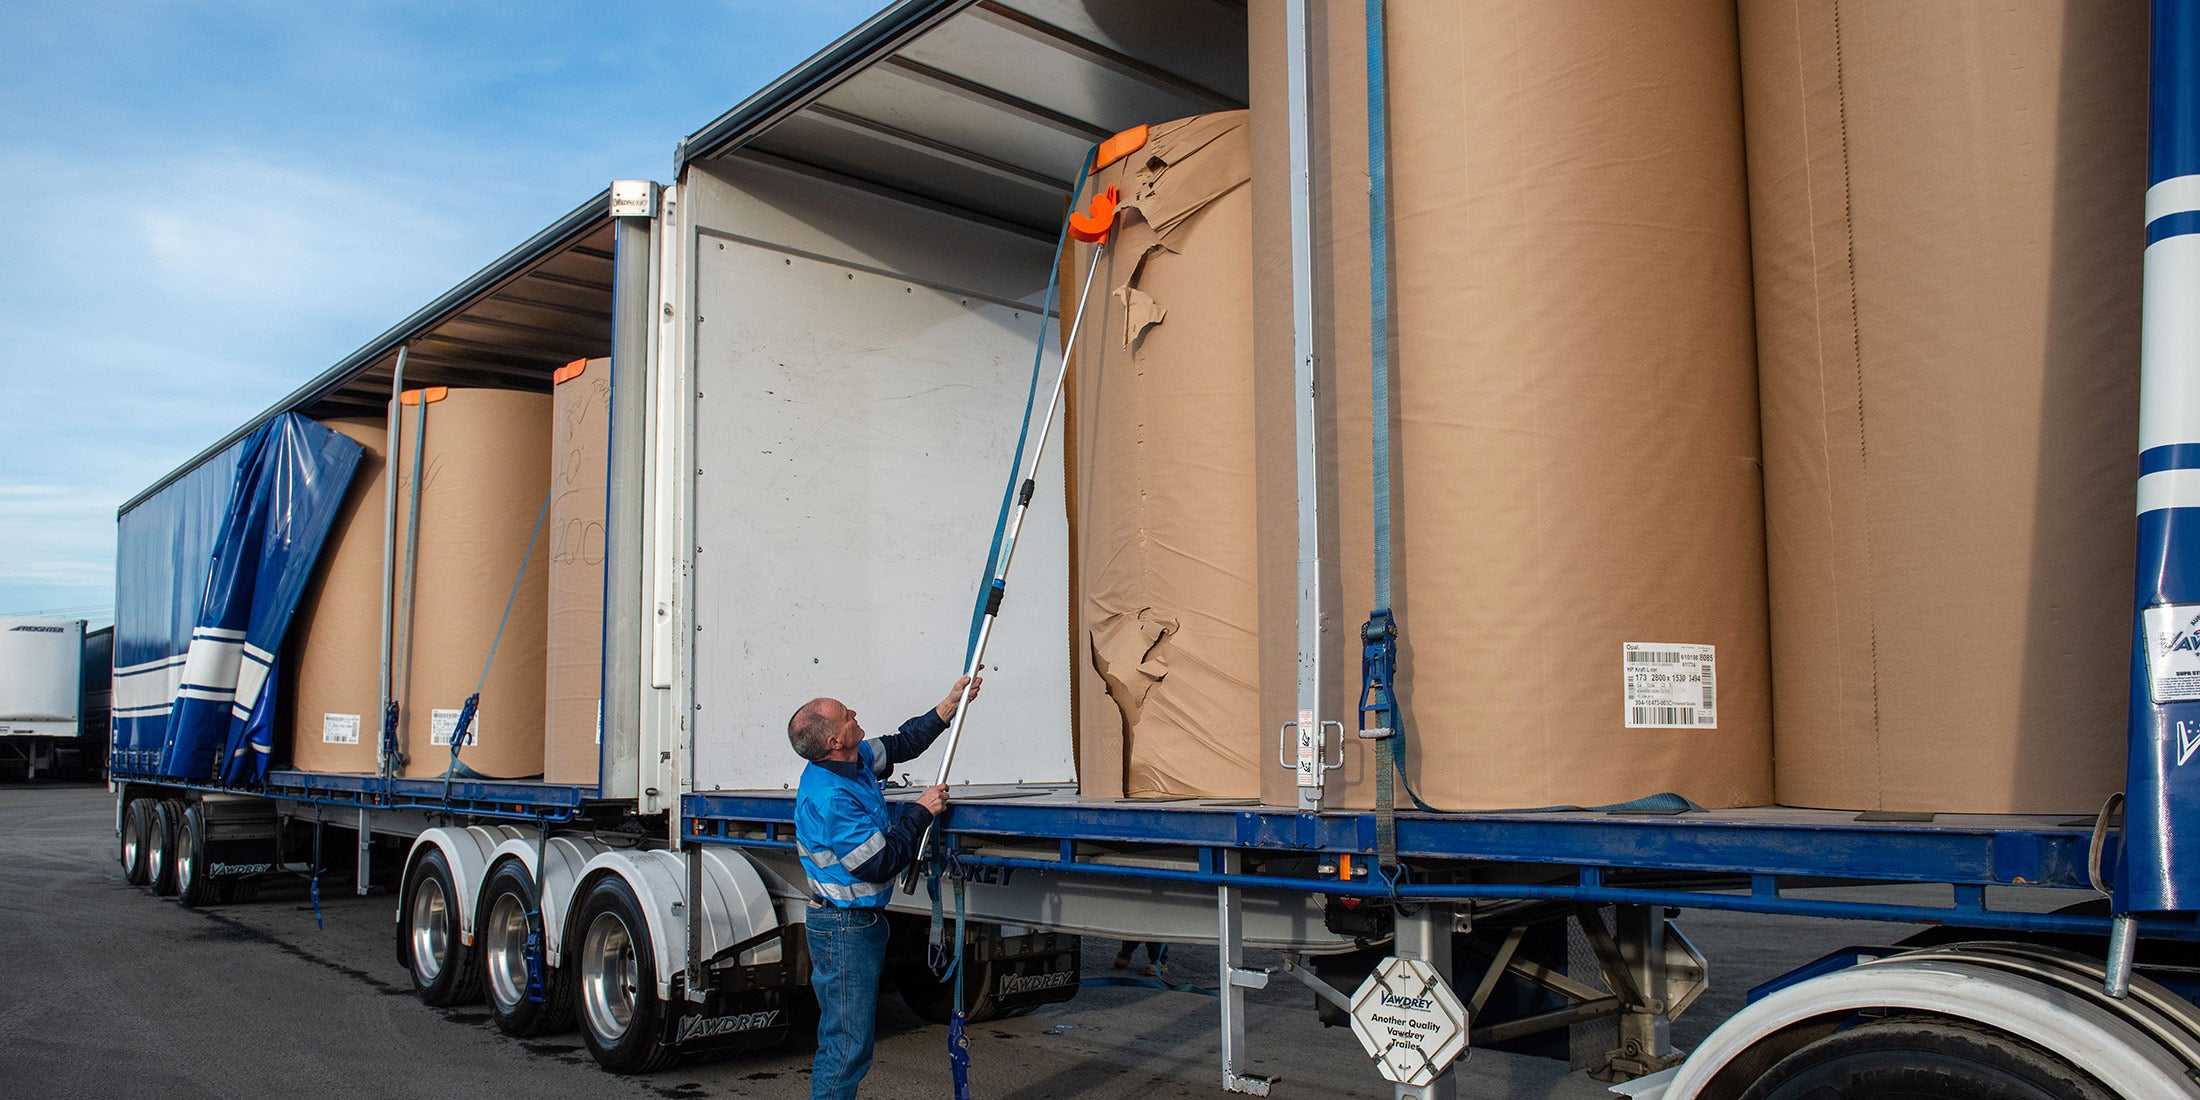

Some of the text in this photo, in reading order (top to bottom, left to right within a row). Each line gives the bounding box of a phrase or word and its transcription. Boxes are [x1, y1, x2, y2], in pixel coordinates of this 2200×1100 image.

[209, 862, 271, 879] VAWDREY
[999, 970, 1074, 1001] VAWDREY
[1381, 989, 1433, 1009] VAWDREY
[676, 1010, 780, 1045] VAWDREY
[1371, 1014, 1440, 1033] Another Quality
[1387, 1027, 1425, 1042] Vawdrey
[1391, 1039, 1420, 1051] Trailer
